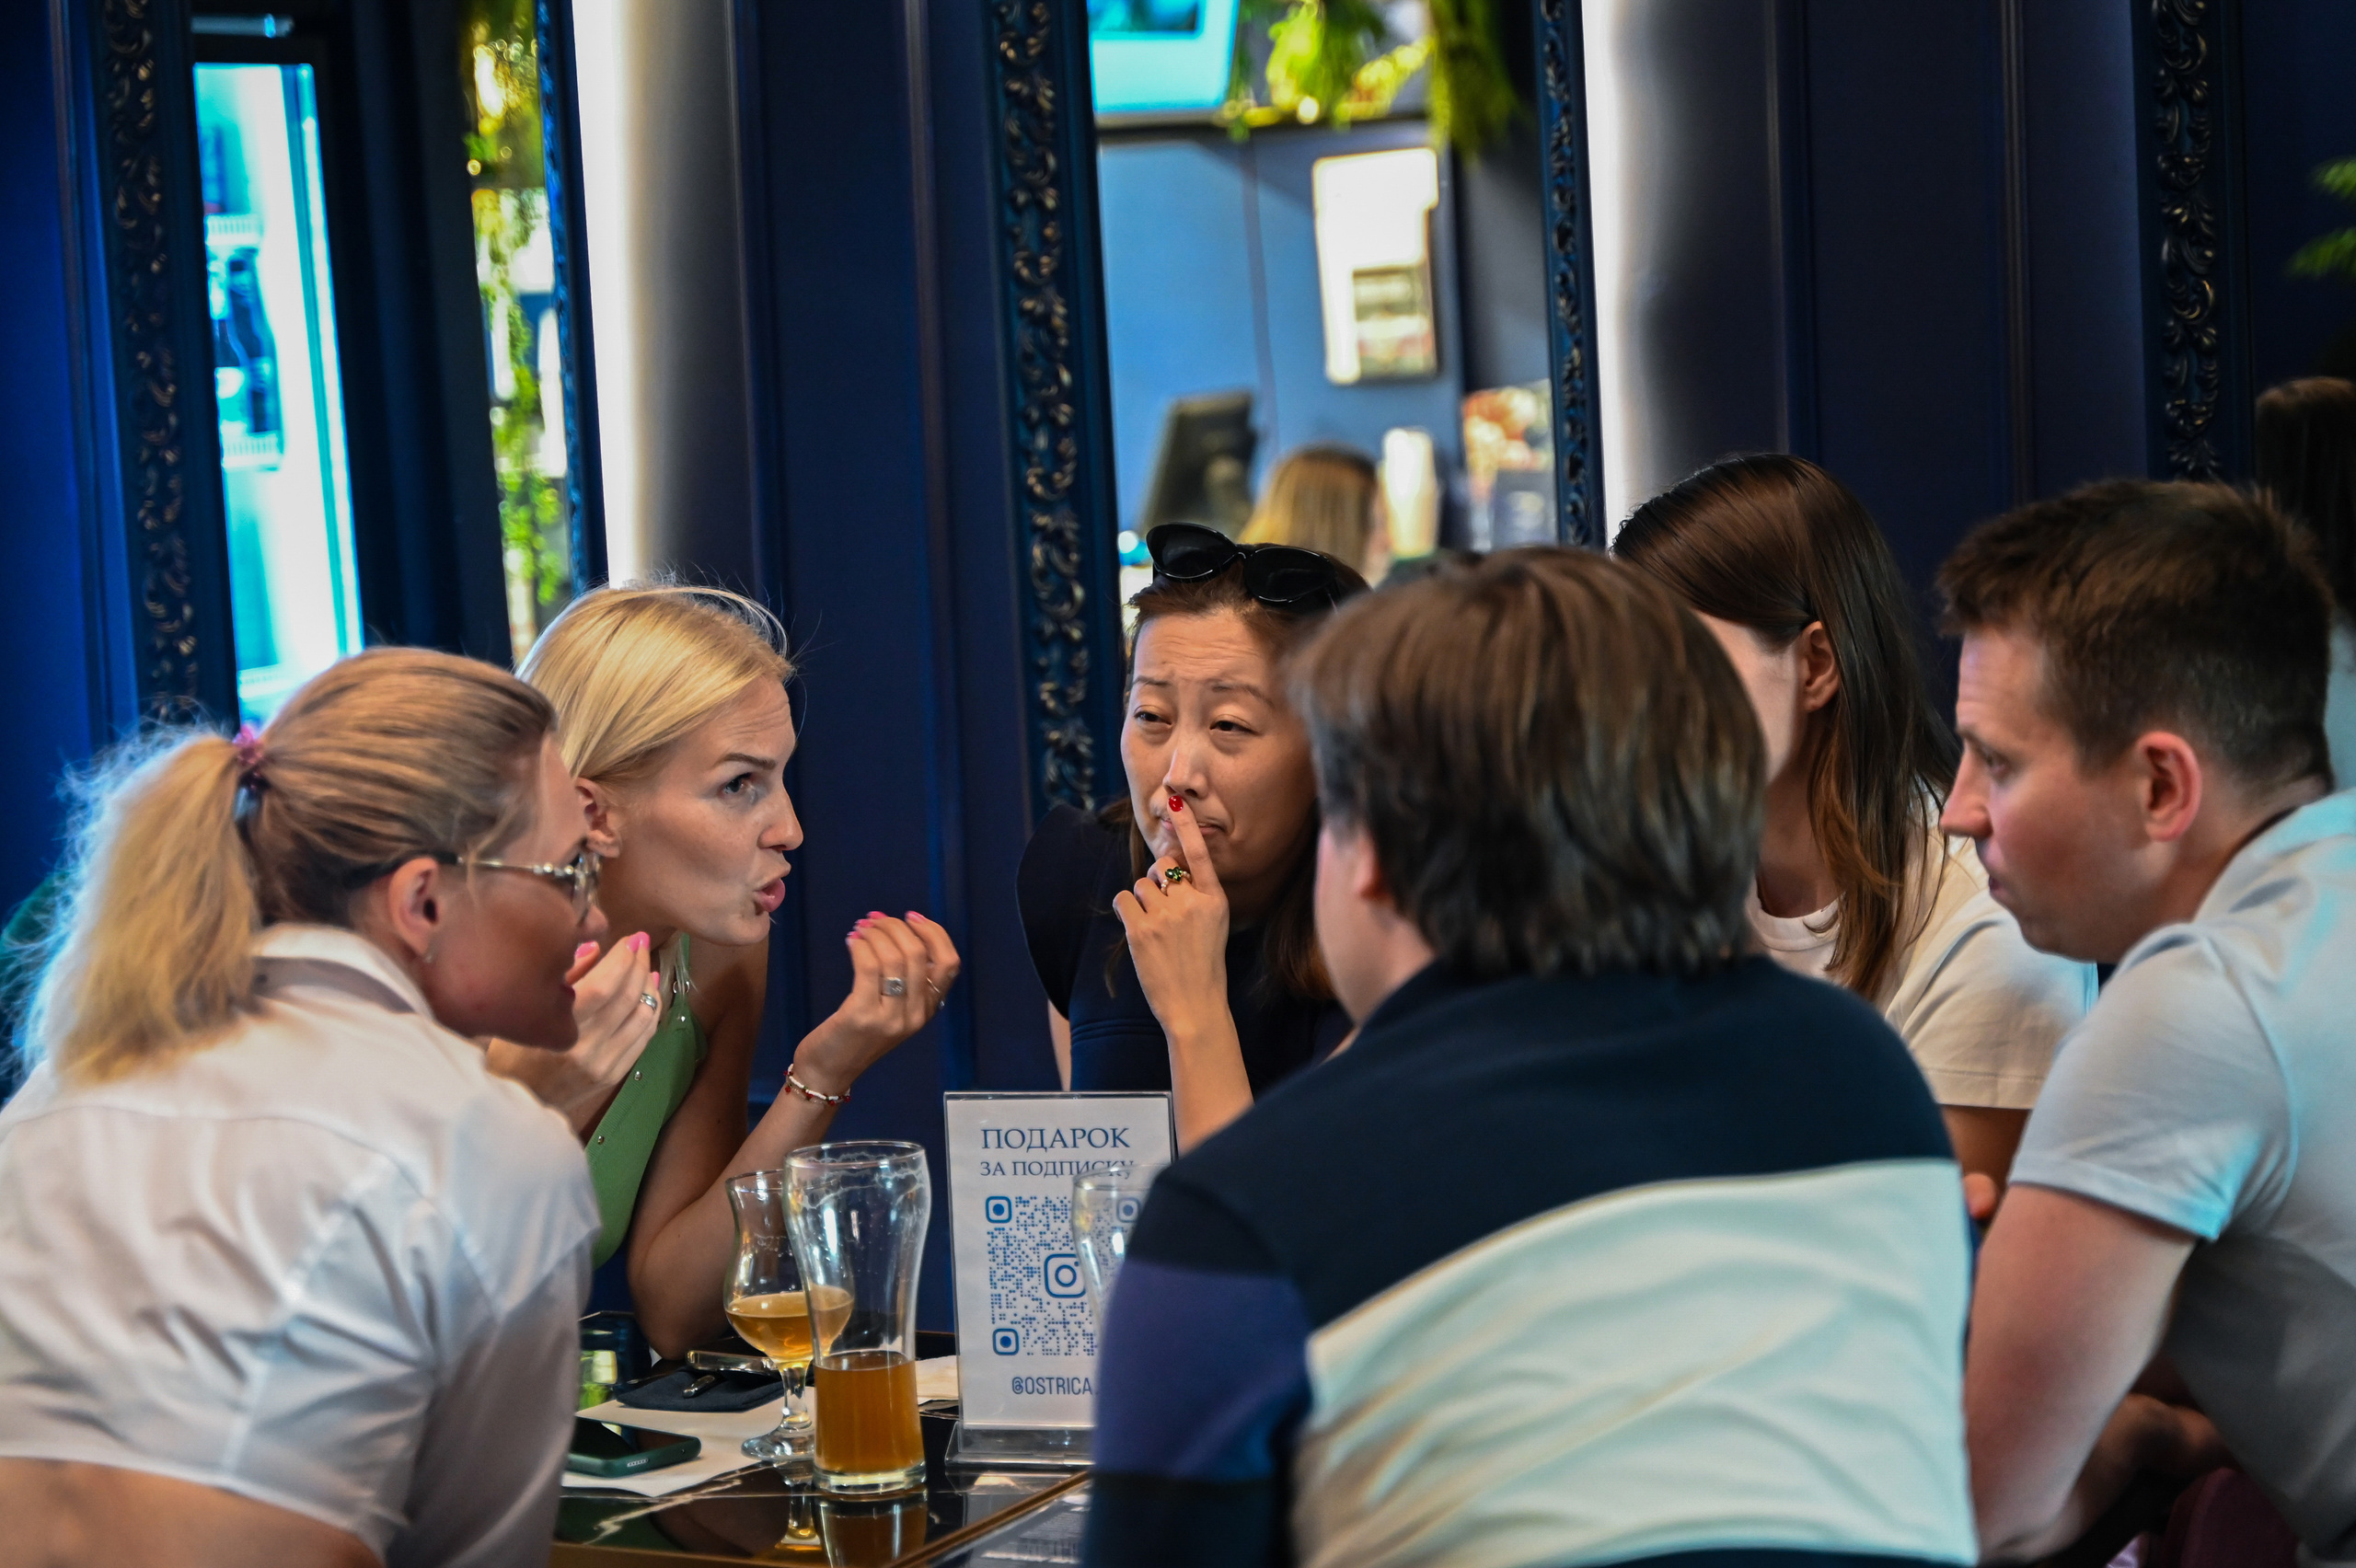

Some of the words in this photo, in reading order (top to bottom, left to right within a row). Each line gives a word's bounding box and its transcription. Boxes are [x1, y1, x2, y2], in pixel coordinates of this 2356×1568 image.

[981, 1127, 1130, 1153] ПОДАРОК
[980, 1161, 1006, 1177] ЗА
[1011, 1377, 1096, 1395] @OSTRICA
